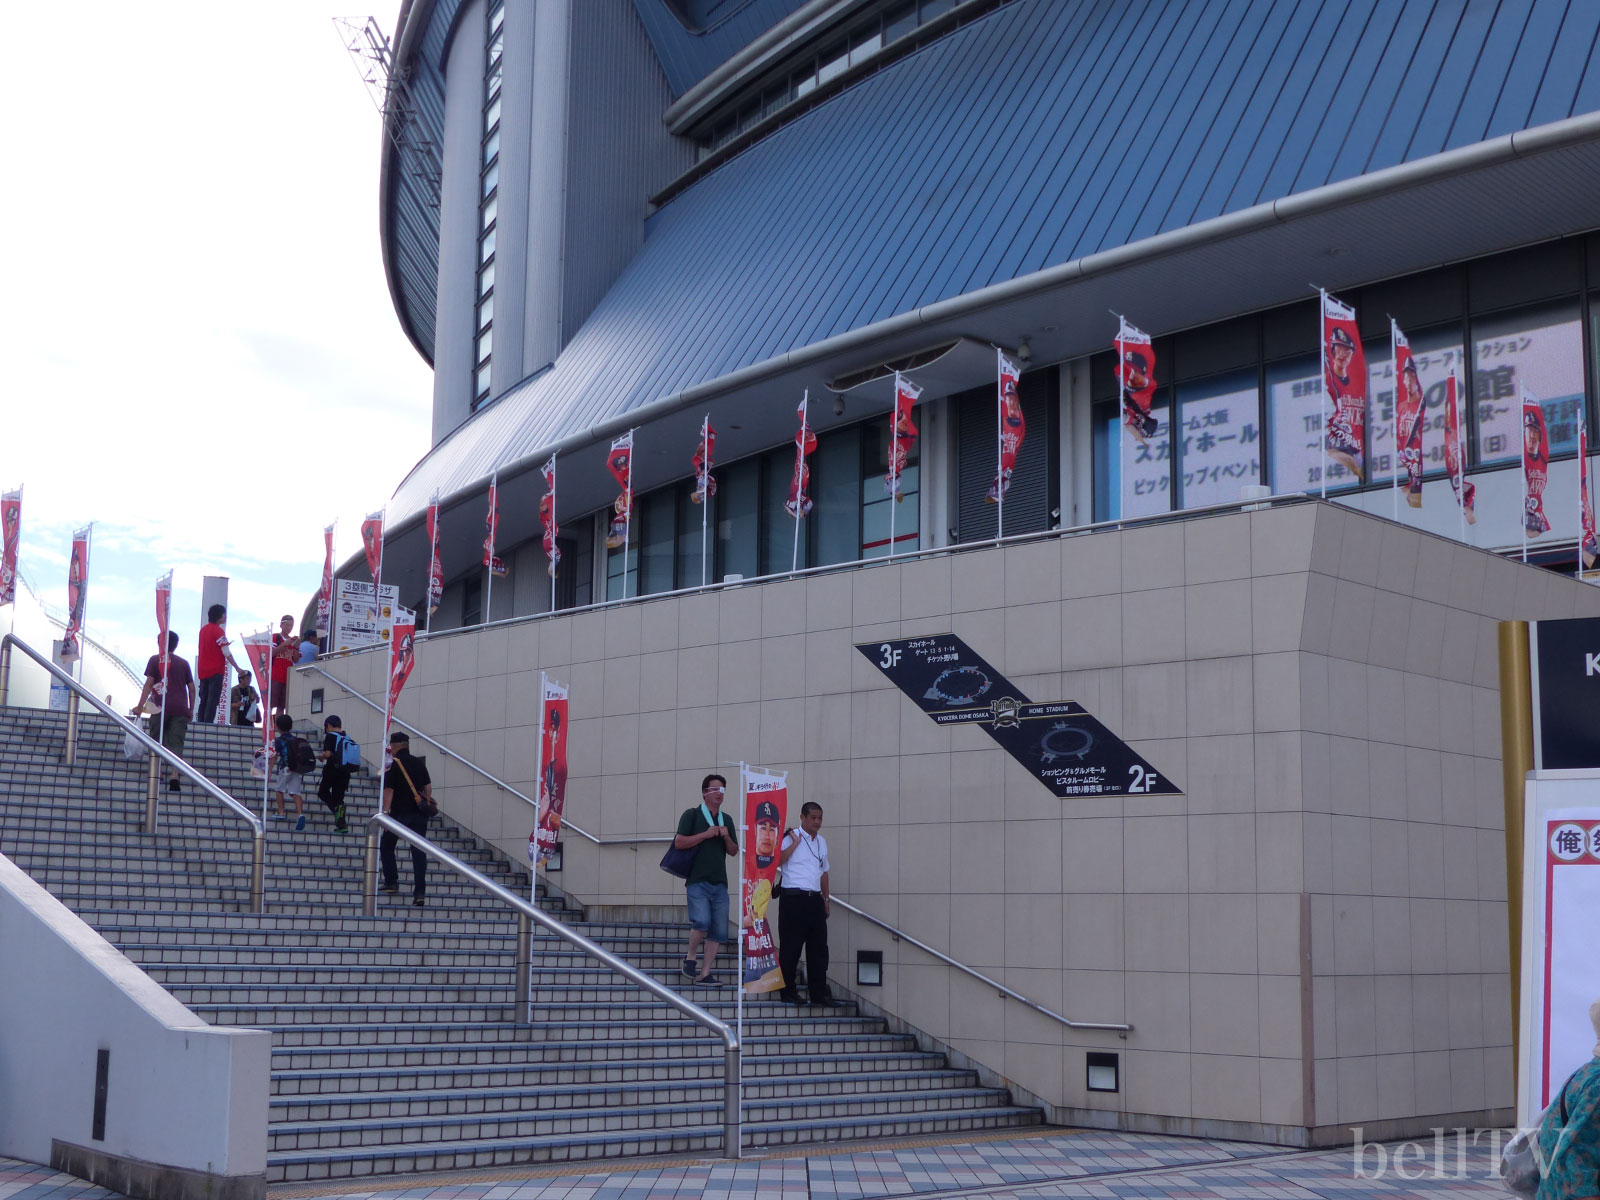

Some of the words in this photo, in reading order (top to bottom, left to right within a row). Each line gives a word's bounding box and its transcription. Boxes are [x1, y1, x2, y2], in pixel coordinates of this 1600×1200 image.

[908, 639, 936, 649] スカイホール
[879, 643, 902, 669] 3F
[926, 652, 959, 664] チケット売り場
[1128, 764, 1157, 793] 2F
